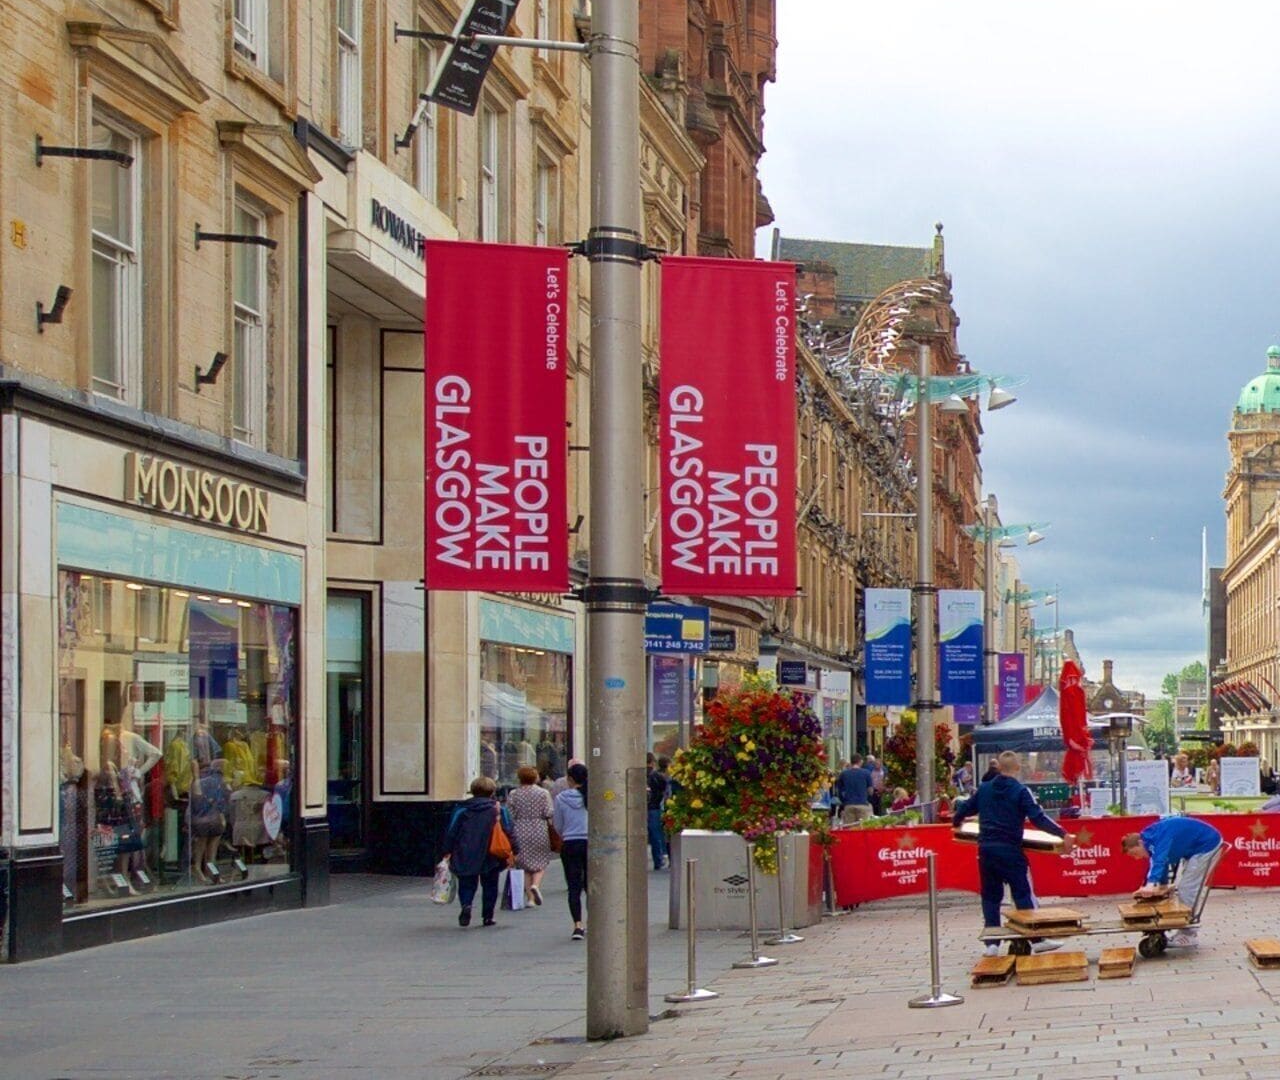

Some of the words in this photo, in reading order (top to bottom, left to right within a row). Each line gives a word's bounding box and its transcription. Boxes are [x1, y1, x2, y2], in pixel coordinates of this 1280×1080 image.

[547, 267, 557, 298] Let's
[776, 281, 788, 312] Let's
[546, 303, 560, 370] Celebrate
[776, 315, 790, 381] Celebrate
[133, 452, 271, 536] MONSOON
[434, 375, 471, 569] GLASGOW
[475, 463, 510, 570] MAKE
[514, 435, 549, 570] PEOPLE
[669, 384, 704, 574] GLASGOW
[707, 471, 741, 575] MAKE
[744, 444, 778, 576] PEOPLE
